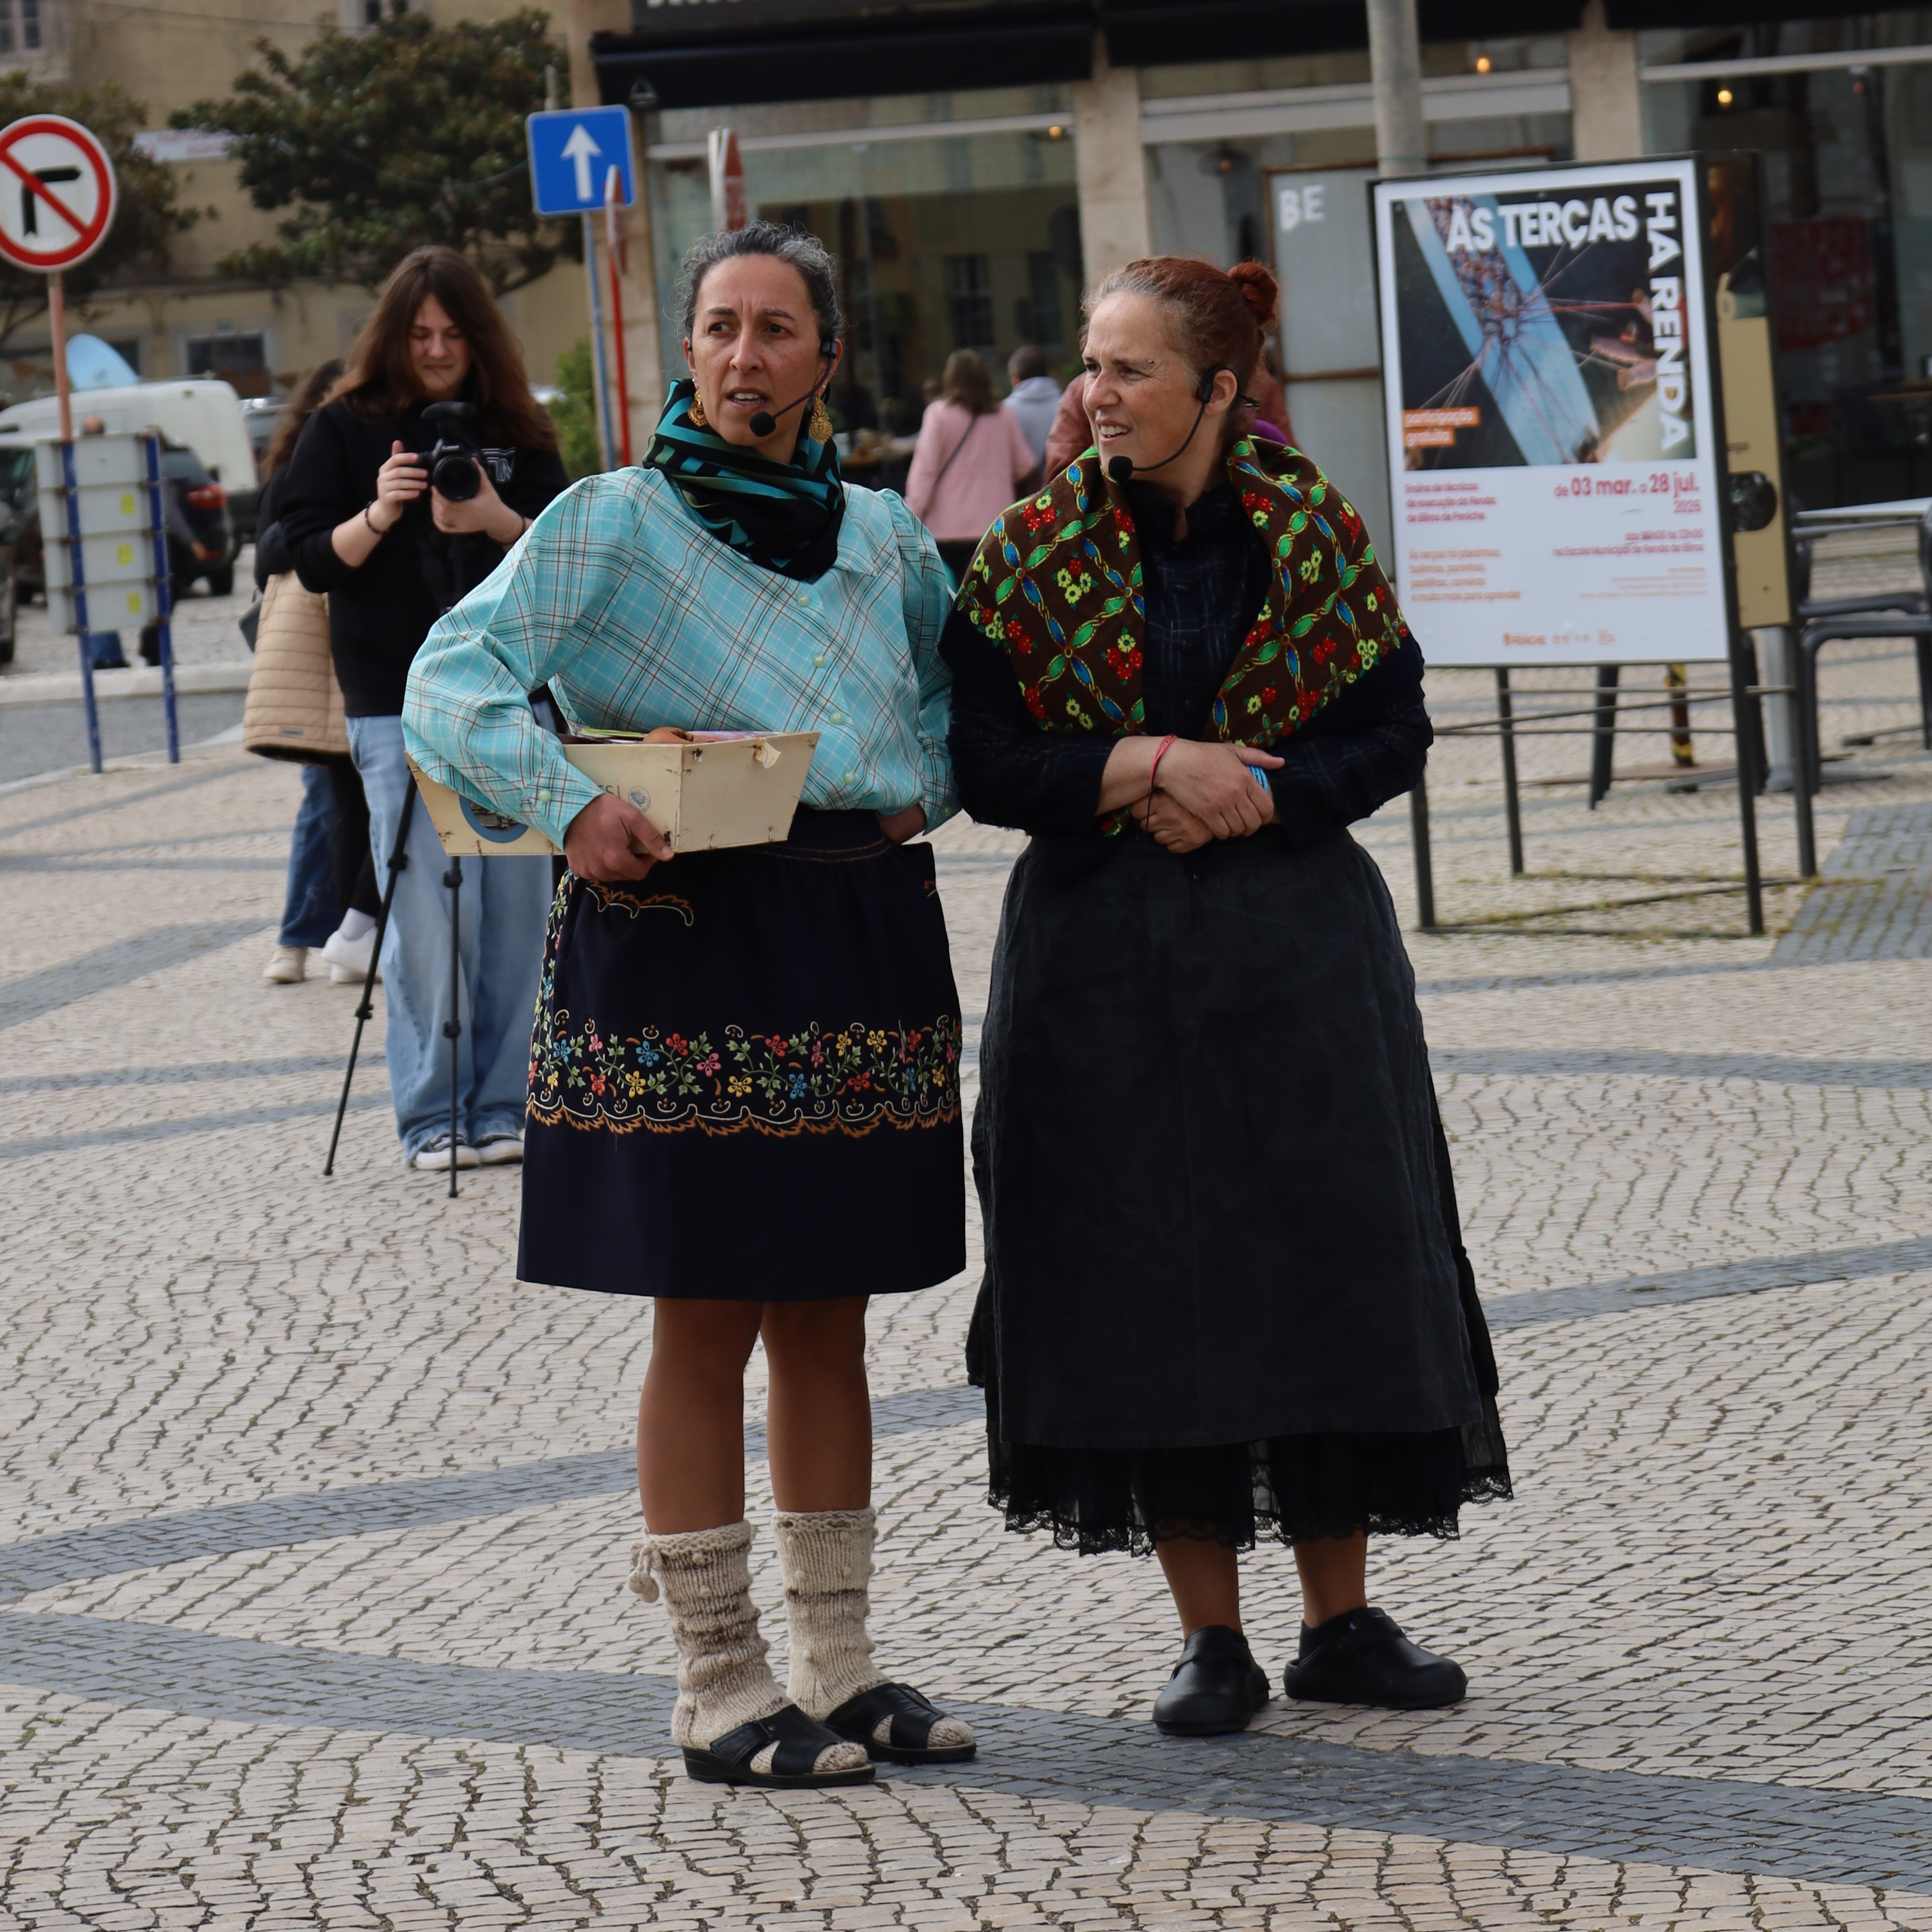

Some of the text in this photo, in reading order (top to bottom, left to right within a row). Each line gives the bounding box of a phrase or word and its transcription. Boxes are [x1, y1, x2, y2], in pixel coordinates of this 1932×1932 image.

[1497, 195, 1639, 250] TERÇAS
[1650, 276, 1688, 450] RENDA
[1406, 408, 1473, 426] participação
[1407, 428, 1450, 446] gratuita
[1554, 484, 1568, 496] de
[1571, 477, 1590, 495] 03
[1596, 479, 1636, 495] mar.
[1649, 473, 1669, 493] 28
[1673, 472, 1699, 499] jul.
[1673, 500, 1702, 513] 2026
